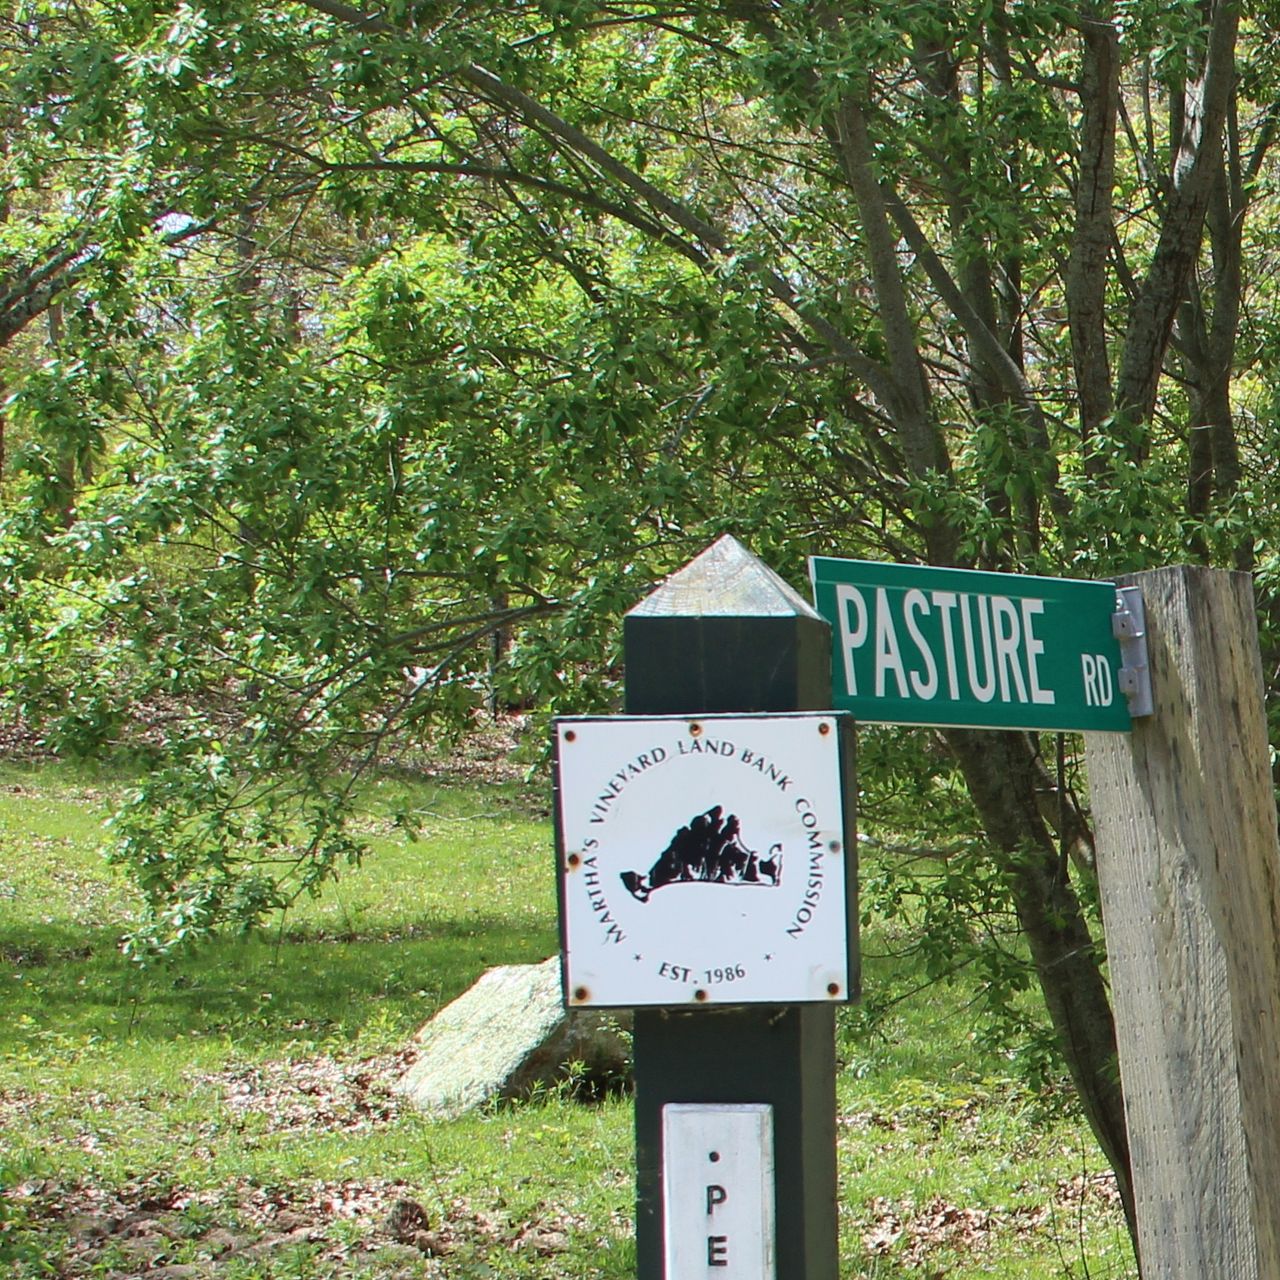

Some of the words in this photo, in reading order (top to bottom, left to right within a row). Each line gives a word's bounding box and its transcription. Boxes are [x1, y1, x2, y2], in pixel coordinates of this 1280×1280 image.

[835, 584, 1056, 704] PASTURE
[1081, 653, 1114, 707] RD
[590, 746, 667, 826] VINEYARD
[677, 738, 736, 758] LAND
[740, 749, 794, 792] BANK
[581, 837, 628, 945] MARTHA'S
[785, 797, 825, 941] COMMISSION
[658, 961, 699, 985] EST.
[704, 964, 746, 985] 1986
